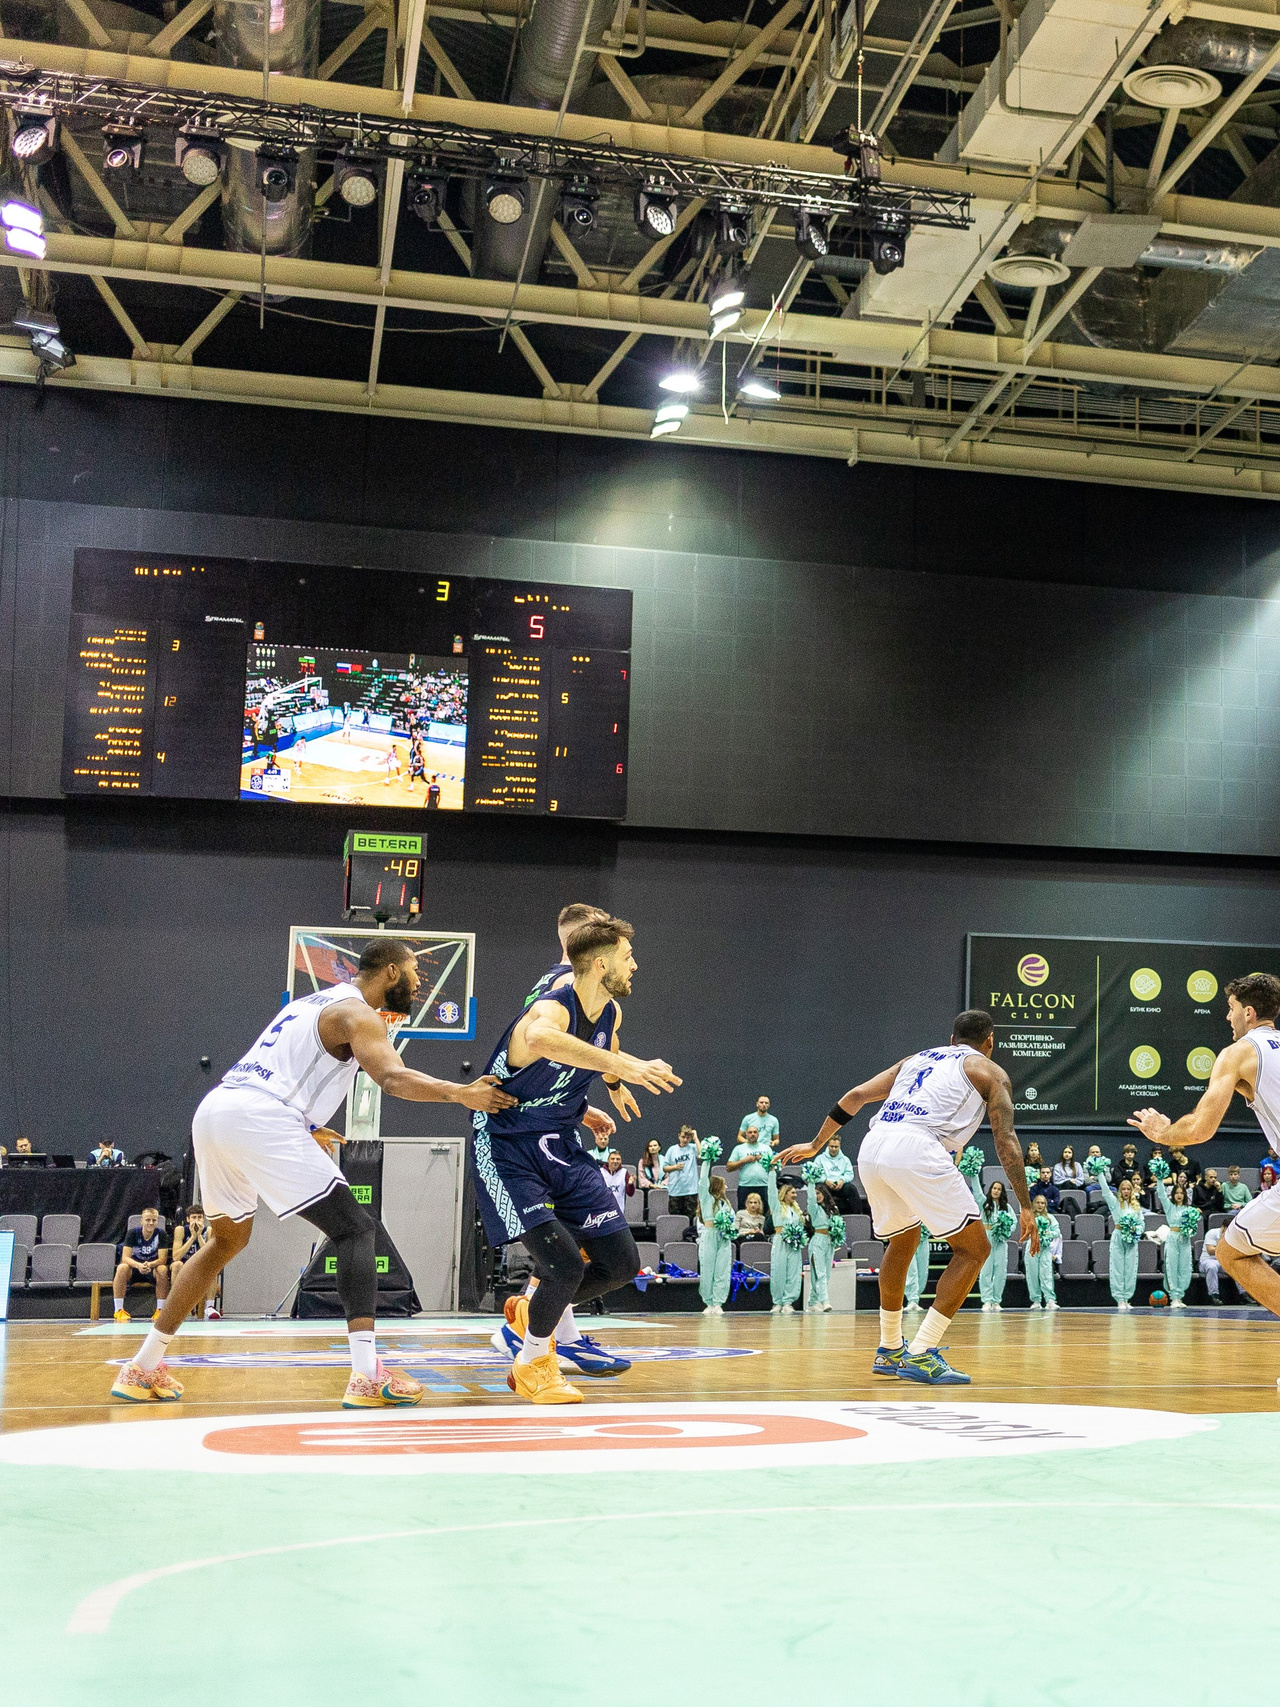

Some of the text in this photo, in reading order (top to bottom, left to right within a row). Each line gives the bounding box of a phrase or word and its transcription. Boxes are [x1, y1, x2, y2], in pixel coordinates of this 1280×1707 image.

[435, 581, 450, 602] 3
[530, 615, 545, 639] 5
[171, 639, 181, 652] 3
[163, 696, 177, 707] 12
[561, 692, 569, 704] 5
[156, 752, 166, 764] 4
[615, 763, 623, 774] 6
[550, 800, 559, 811] 3
[989, 992, 1076, 1009] FALCON
[1010, 1012, 1055, 1020] CLUB
[259, 1014, 299, 1049] 5
[1009, 1034, 1055, 1042] СПОРТИВНО-
[998, 1042, 1066, 1050] РАЗВЛЕКАТЕЛЬНЫЙ
[1012, 1049, 1052, 1058] КОМПЛЕКС
